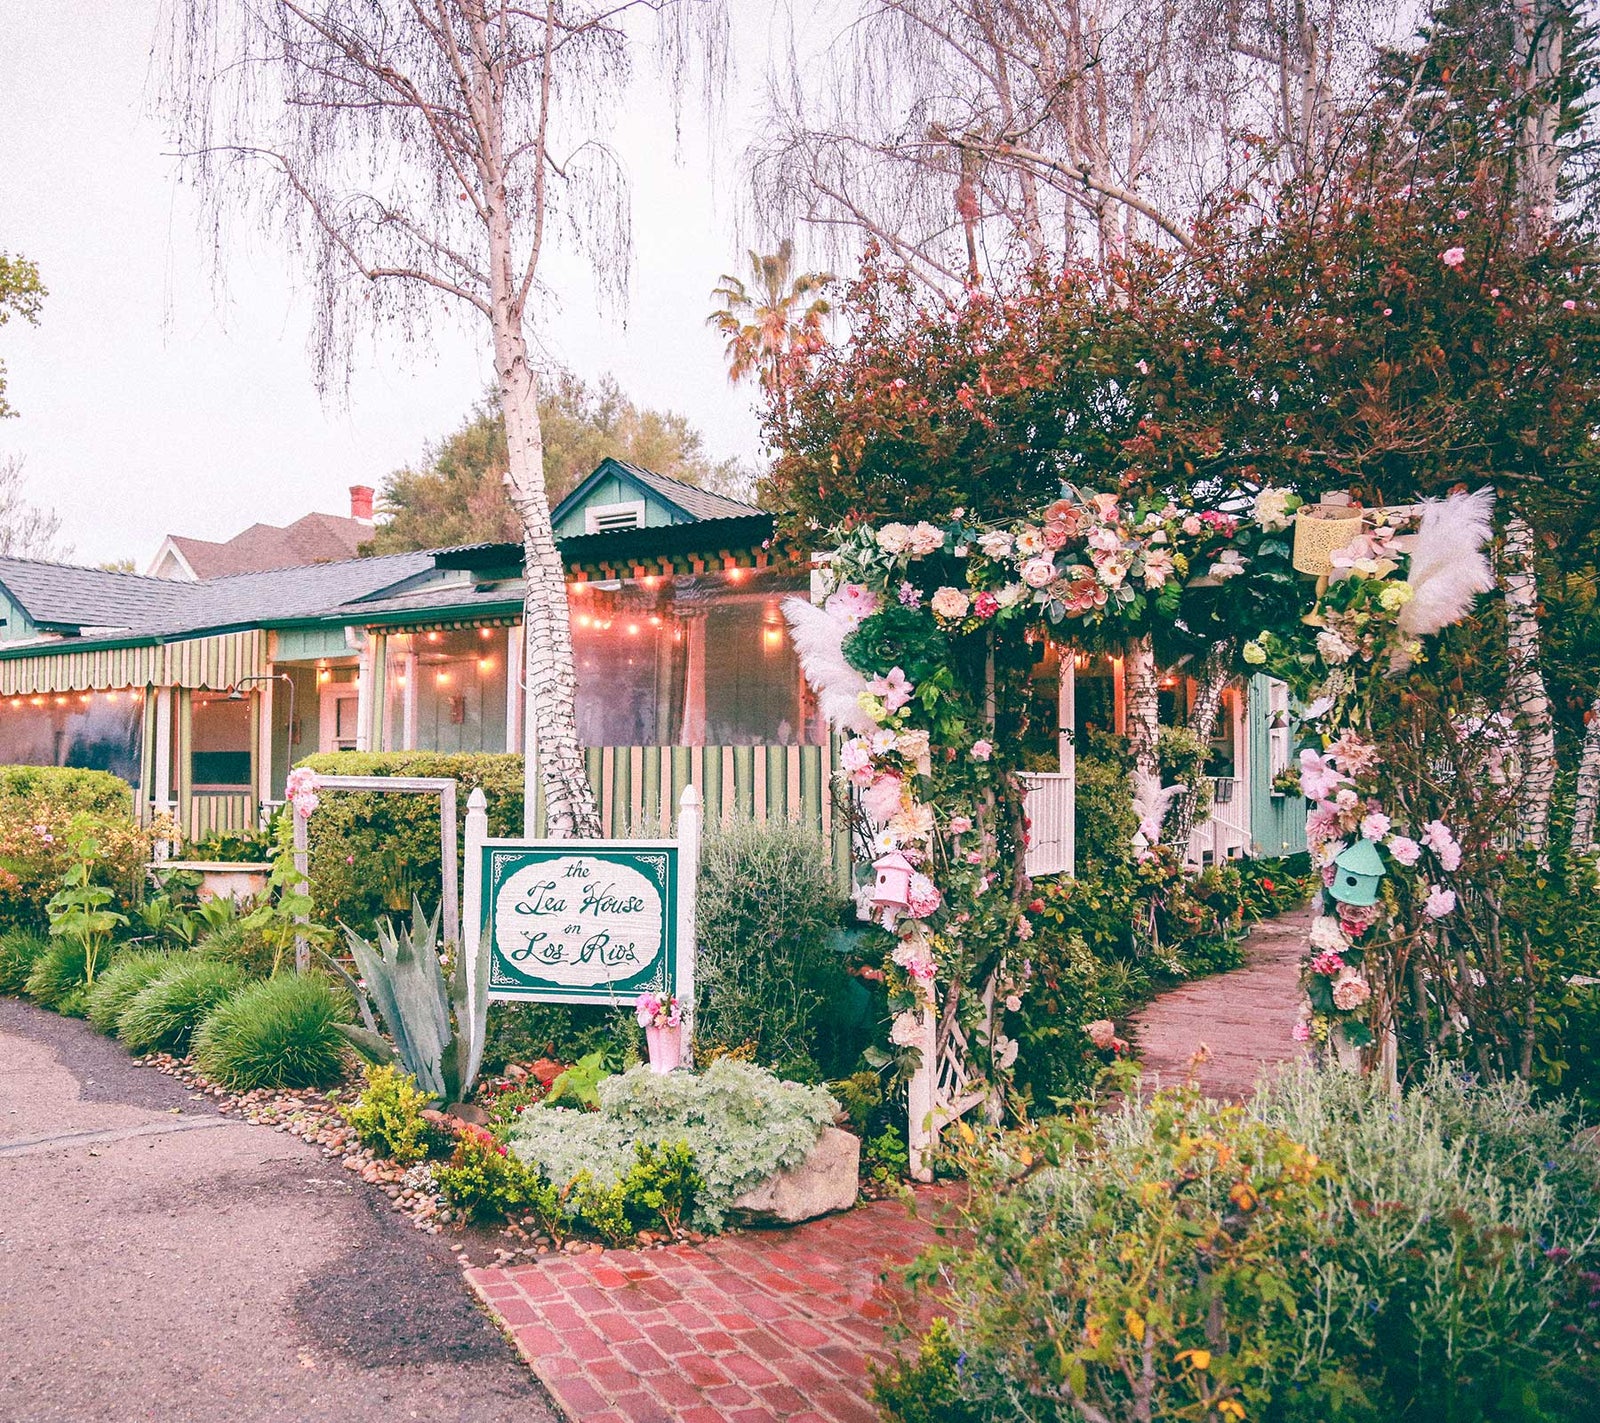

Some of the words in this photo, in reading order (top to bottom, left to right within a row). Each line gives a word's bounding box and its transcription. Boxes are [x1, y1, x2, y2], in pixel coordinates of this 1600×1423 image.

[561, 860, 590, 878] the
[515, 881, 567, 917] Tea
[579, 881, 645, 916] House
[564, 923, 581, 935] on
[511, 931, 569, 965] Los
[570, 928, 640, 966] Rios
